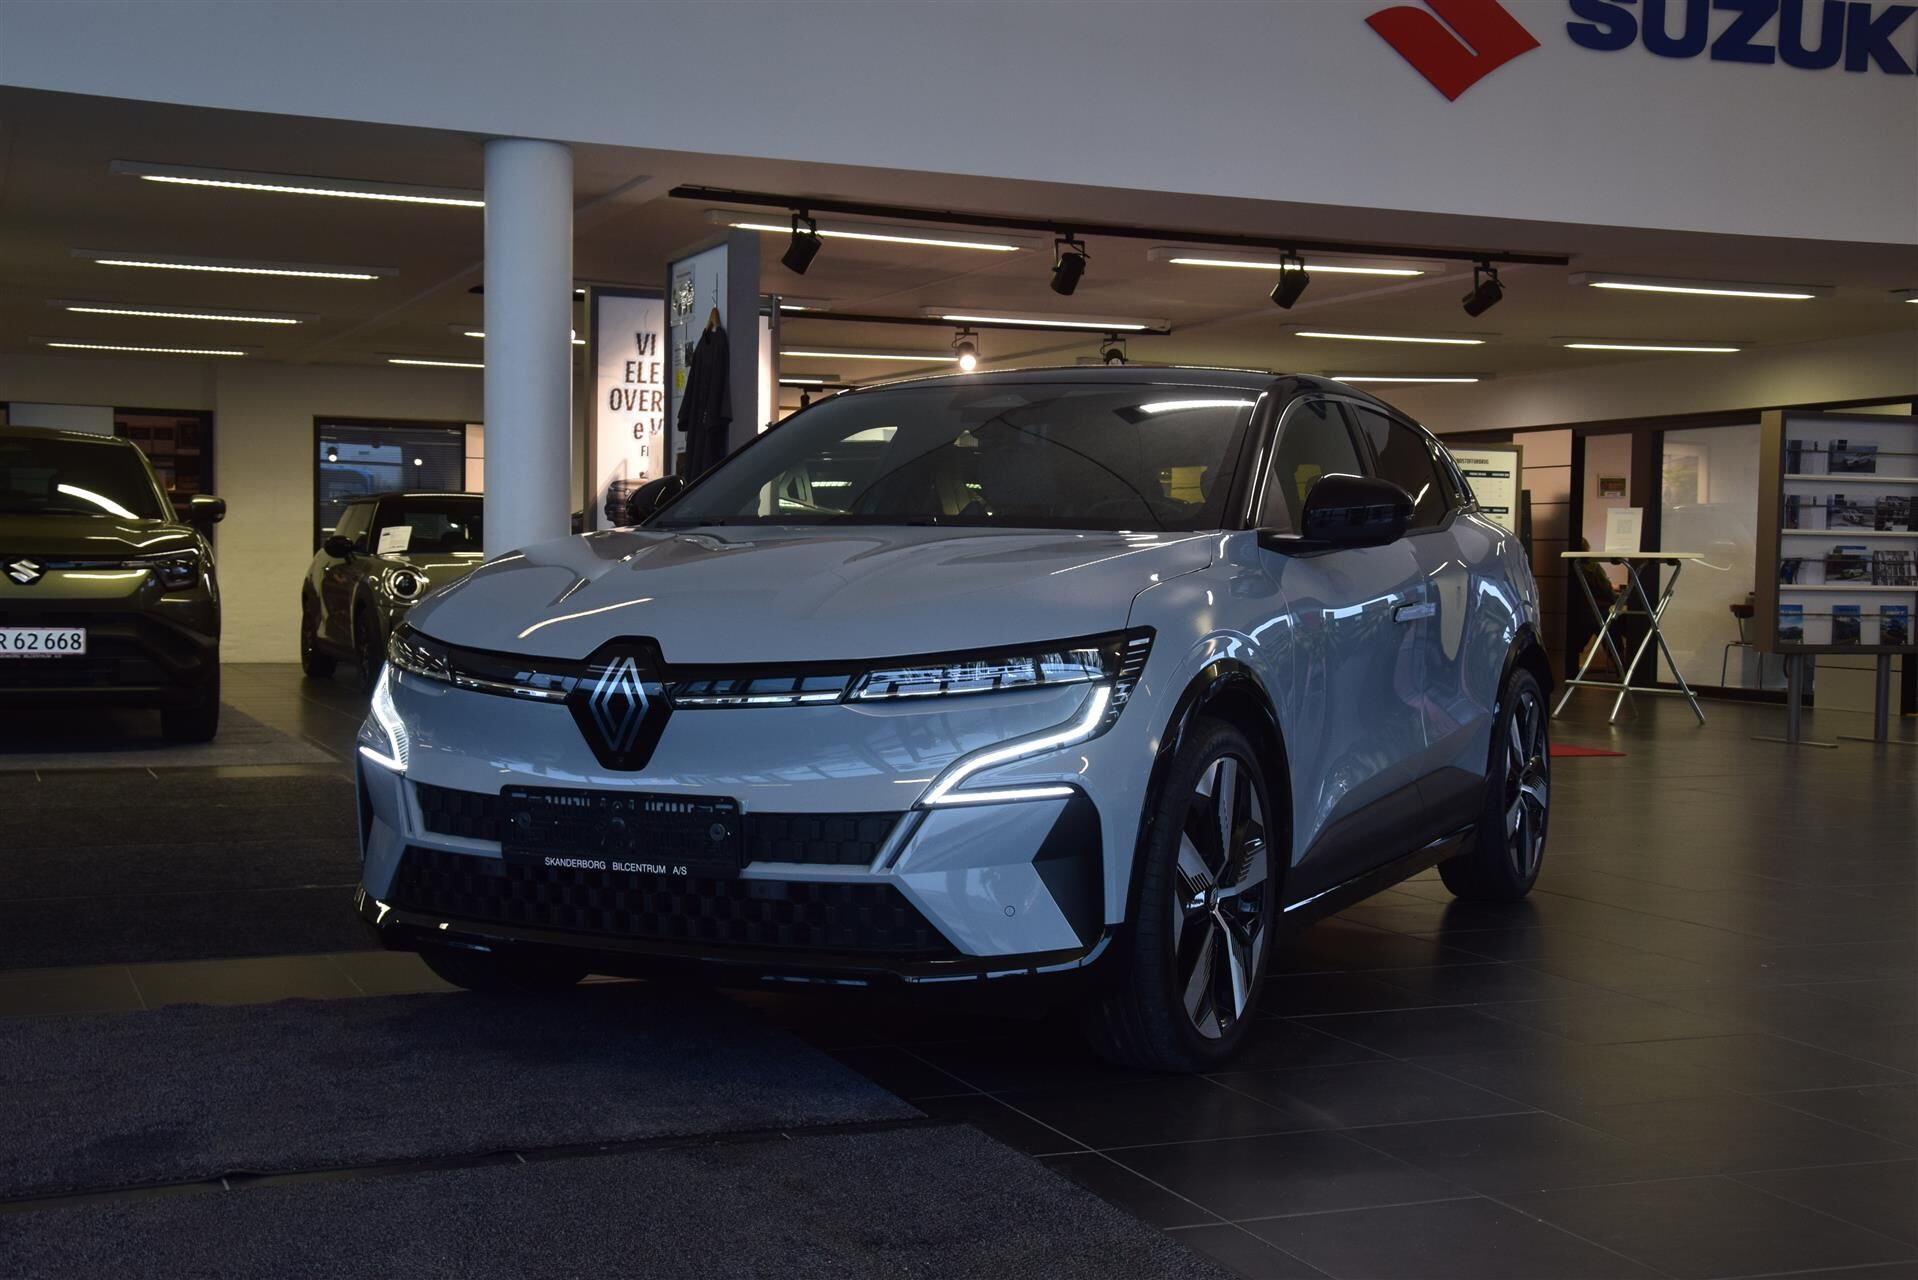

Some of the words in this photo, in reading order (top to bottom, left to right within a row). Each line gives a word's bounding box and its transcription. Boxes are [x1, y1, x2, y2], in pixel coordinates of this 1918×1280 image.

[1566, 0, 1918, 76] SUZUK
[625, 361, 664, 384] ELE
[609, 388, 664, 412] OVER
[14, 632, 38, 650] 62
[44, 632, 82, 650] 668
[544, 856, 607, 870] SKANDERBORG
[612, 861, 667, 874] BILCENTRUM
[672, 866, 688, 876] A/S
